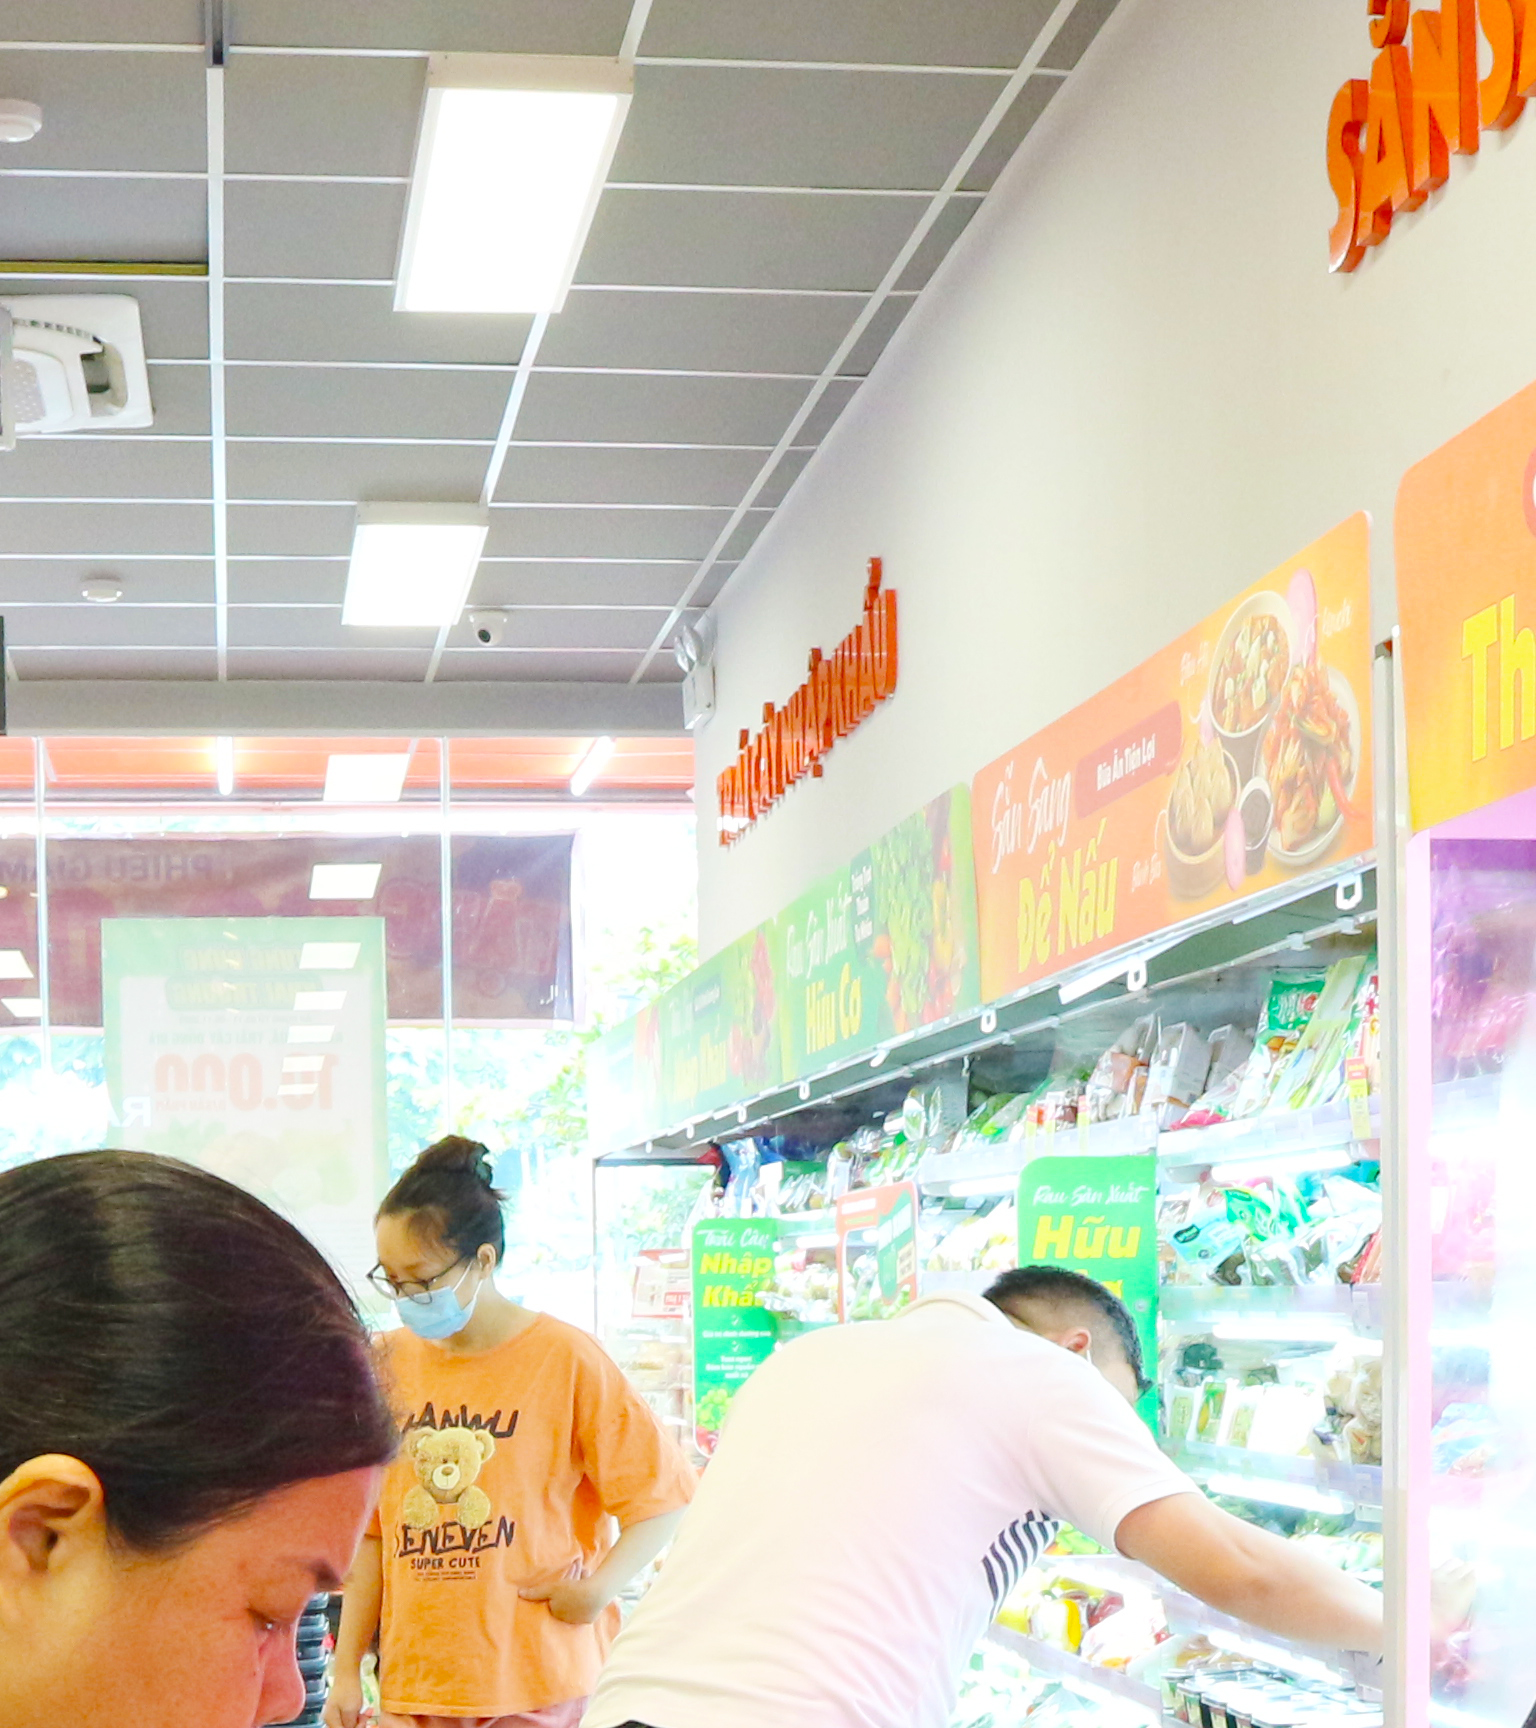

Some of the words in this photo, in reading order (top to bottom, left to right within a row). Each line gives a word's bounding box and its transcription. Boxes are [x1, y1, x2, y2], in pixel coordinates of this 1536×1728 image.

[1016, 843, 1057, 974] Để
[1058, 818, 1120, 956] Nấu
[1033, 1214, 1142, 1260] Hữu
[699, 1252, 772, 1279] Nhập
[410, 1557, 444, 1570] SUPER
[449, 1556, 481, 1569] CUTE
